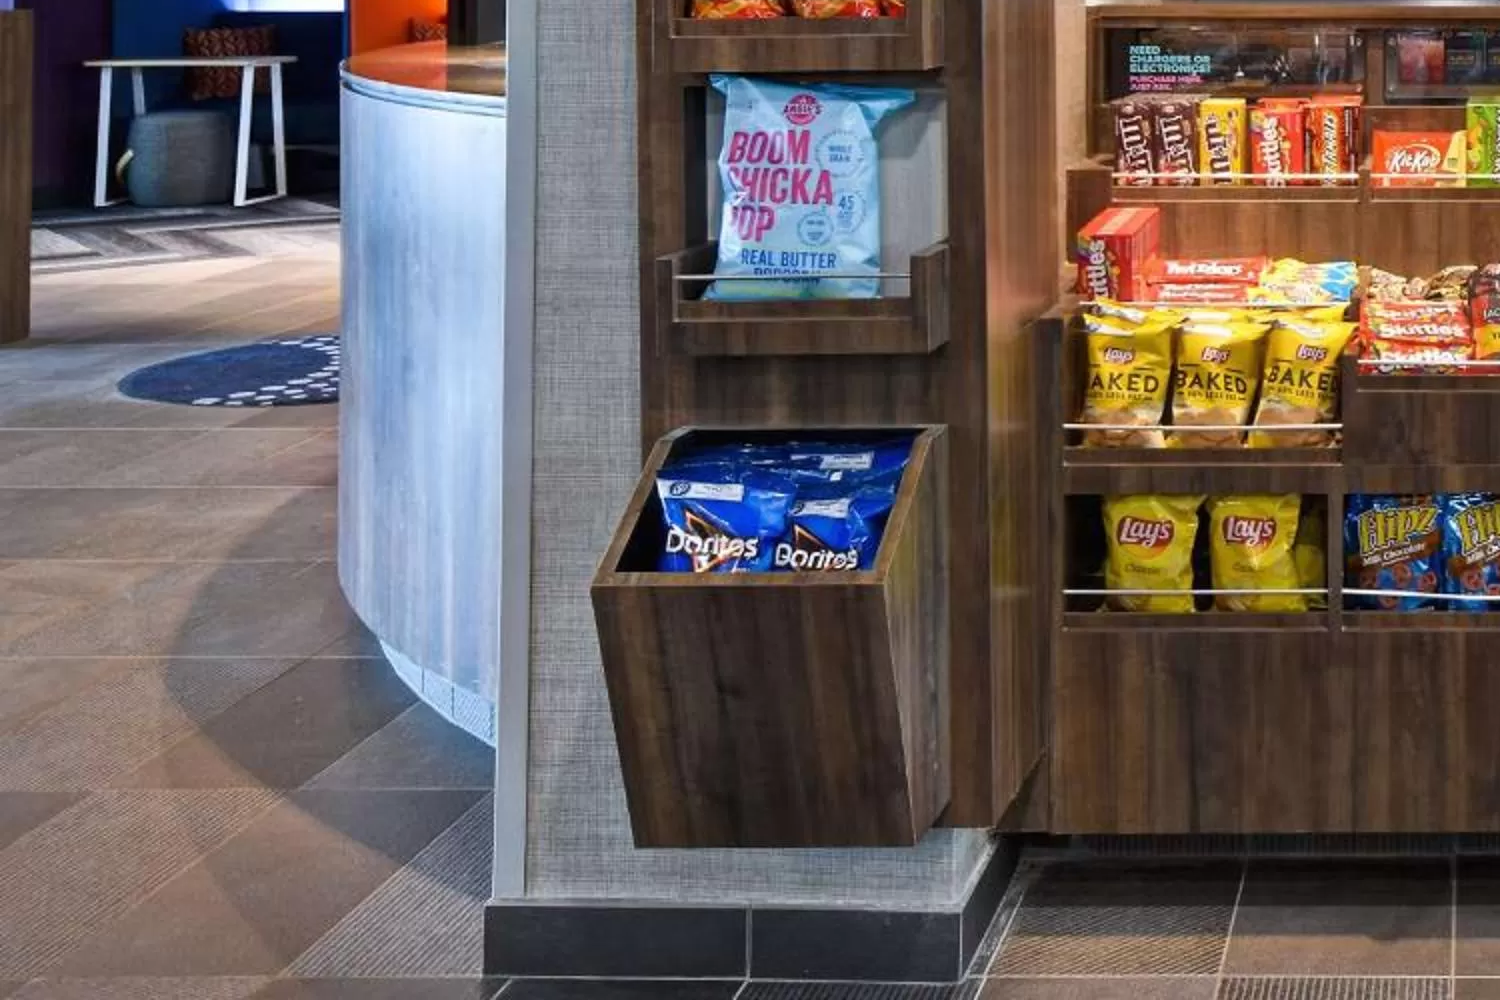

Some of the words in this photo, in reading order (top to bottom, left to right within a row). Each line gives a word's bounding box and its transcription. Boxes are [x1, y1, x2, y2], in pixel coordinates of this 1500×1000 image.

[1129, 45, 1161, 55] NEED
[727, 129, 811, 166] BOOM
[740, 247, 776, 266] REAL
[780, 250, 837, 269] BUTTER
[1091, 371, 1160, 393] AKED
[666, 530, 760, 558] Doritos
[1120, 517, 1174, 548] Lay's
[1226, 516, 1276, 545] Lay's
[774, 543, 860, 570] Doritos
